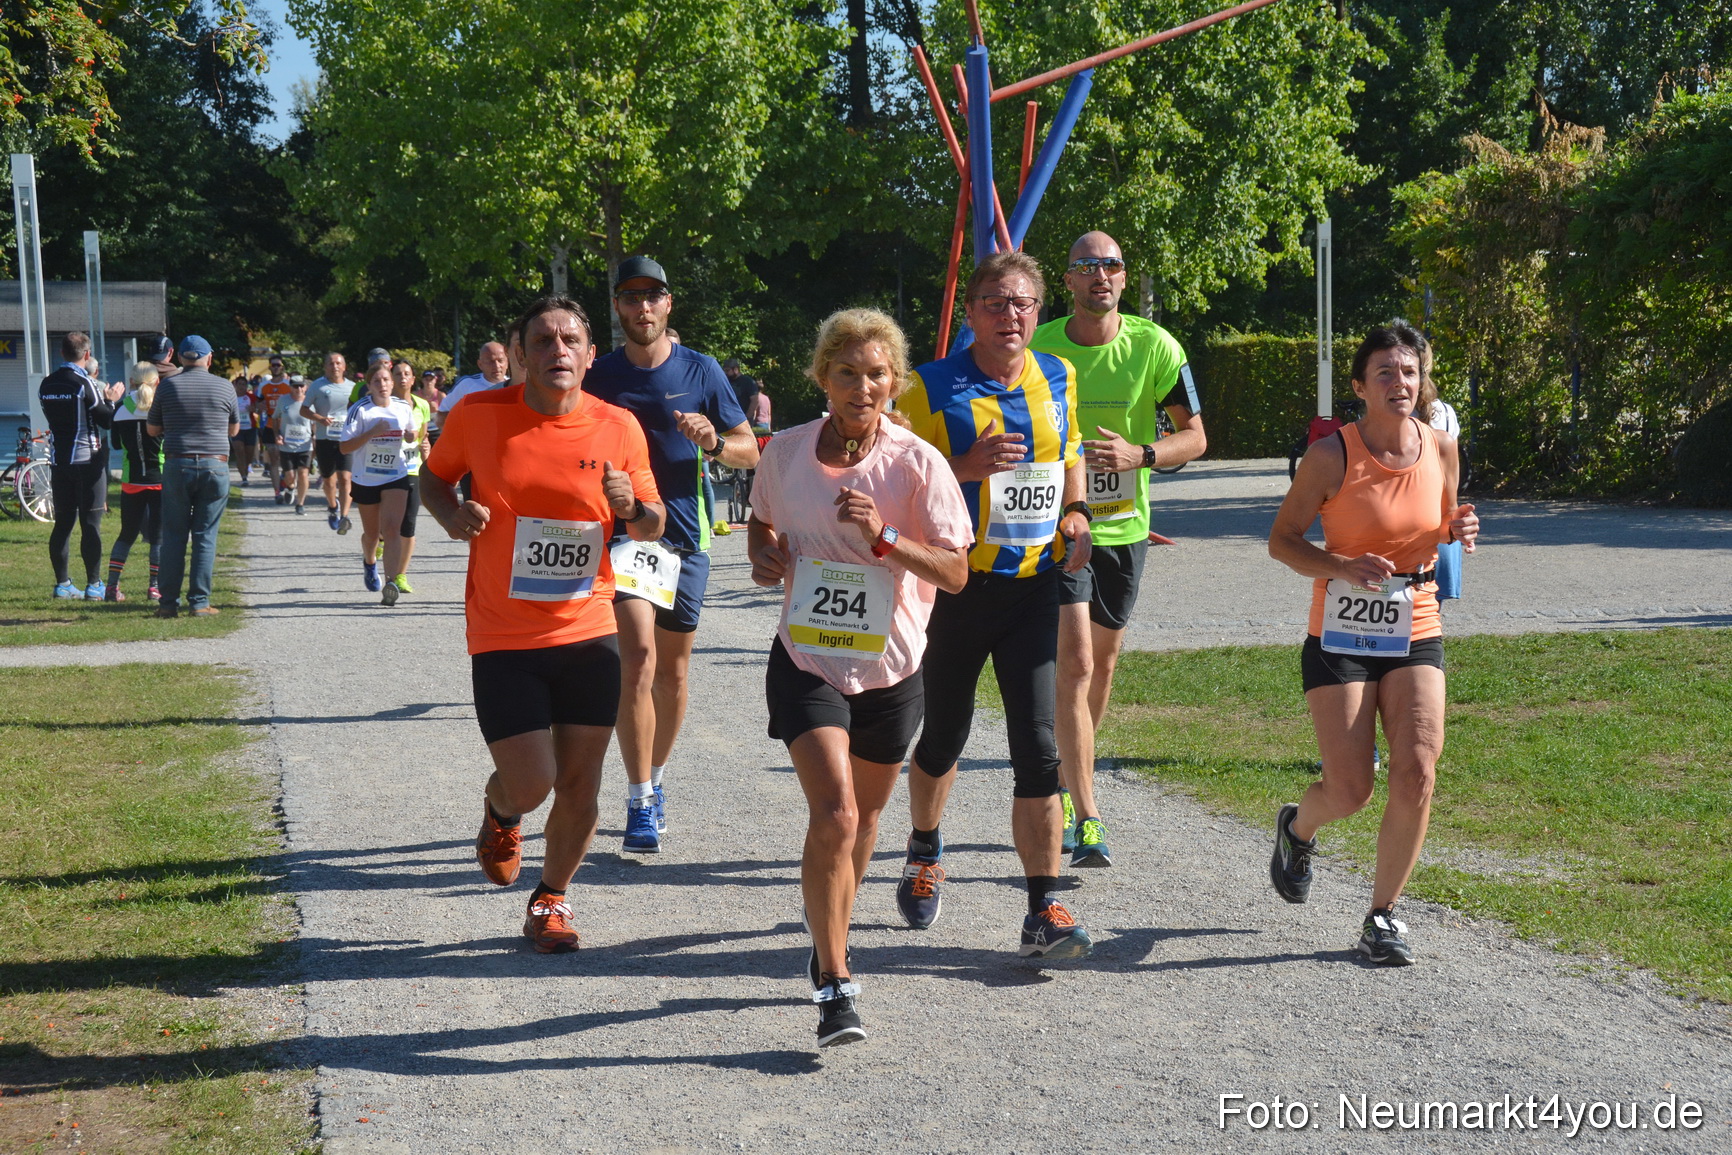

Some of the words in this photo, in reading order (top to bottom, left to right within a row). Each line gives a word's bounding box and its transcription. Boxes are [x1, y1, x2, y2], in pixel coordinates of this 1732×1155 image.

[371, 453, 396, 465] 2197
[1014, 469, 1050, 480] BOCK
[1003, 485, 1056, 511] 3059
[542, 525, 582, 538] BOCK
[527, 541, 591, 568] 3058
[821, 568, 865, 584] BOCK
[811, 586, 867, 619] 254
[1337, 596, 1400, 625] 2205
[808, 617, 829, 627] PARTL
[829, 621, 860, 630] Neumarkt
[1341, 623, 1360, 632] PARTL
[1360, 626, 1386, 634] Neumarkt
[818, 632, 854, 648] Ingrid
